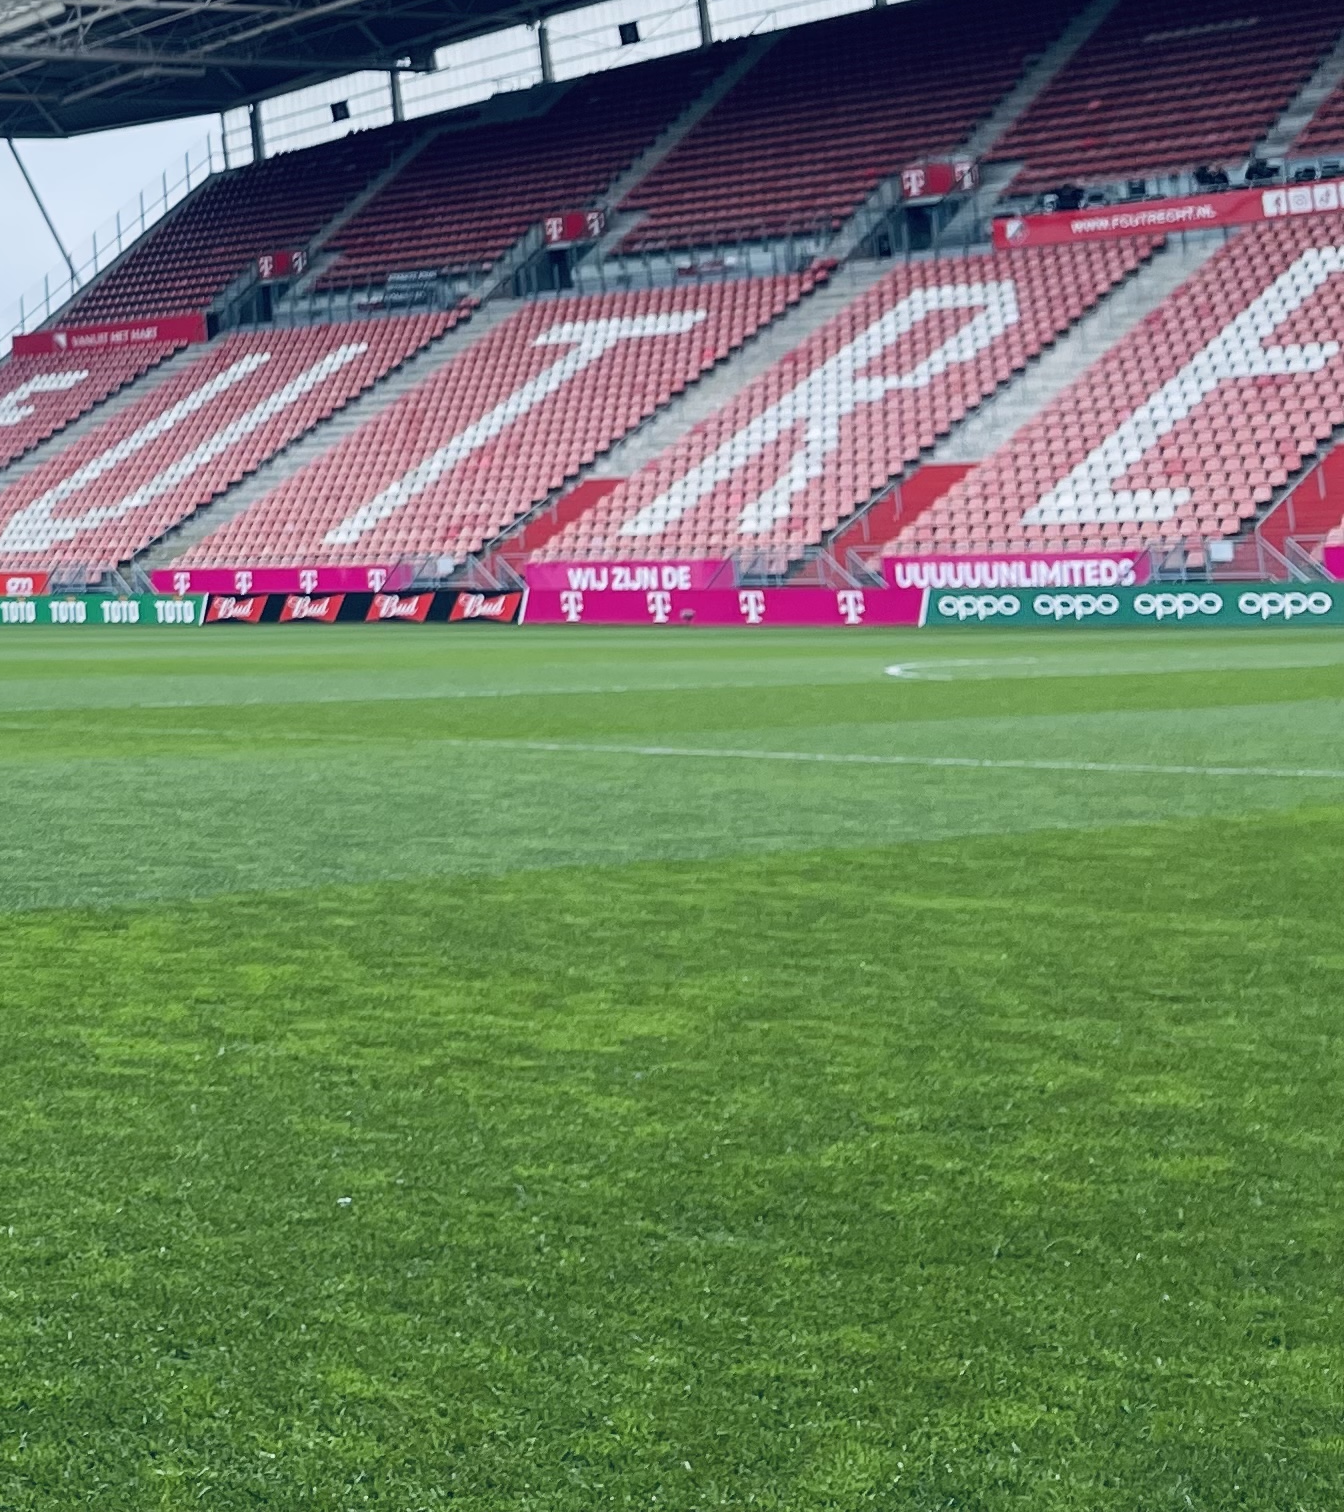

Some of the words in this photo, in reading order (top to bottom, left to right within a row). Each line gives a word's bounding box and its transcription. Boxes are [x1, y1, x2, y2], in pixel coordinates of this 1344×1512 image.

[567, 567, 608, 590] WIJ
[611, 566, 659, 590] ZIJN
[662, 566, 691, 590] DE
[0, 600, 37, 623] TOTO
[49, 600, 87, 623] TOTO
[100, 600, 141, 624] TOTO
[154, 600, 196, 624] TOTO
[215, 595, 254, 619] Bud
[289, 595, 332, 619] Bud
[376, 594, 418, 619] Bud
[459, 593, 504, 618] Bud
[560, 591, 584, 623] T
[647, 591, 672, 625] T
[739, 590, 766, 624] T
[837, 590, 865, 625] T
[938, 595, 1021, 620] oppo
[1033, 594, 1119, 620] oppo
[1134, 592, 1222, 620] oppo
[1238, 591, 1332, 620] oppo
